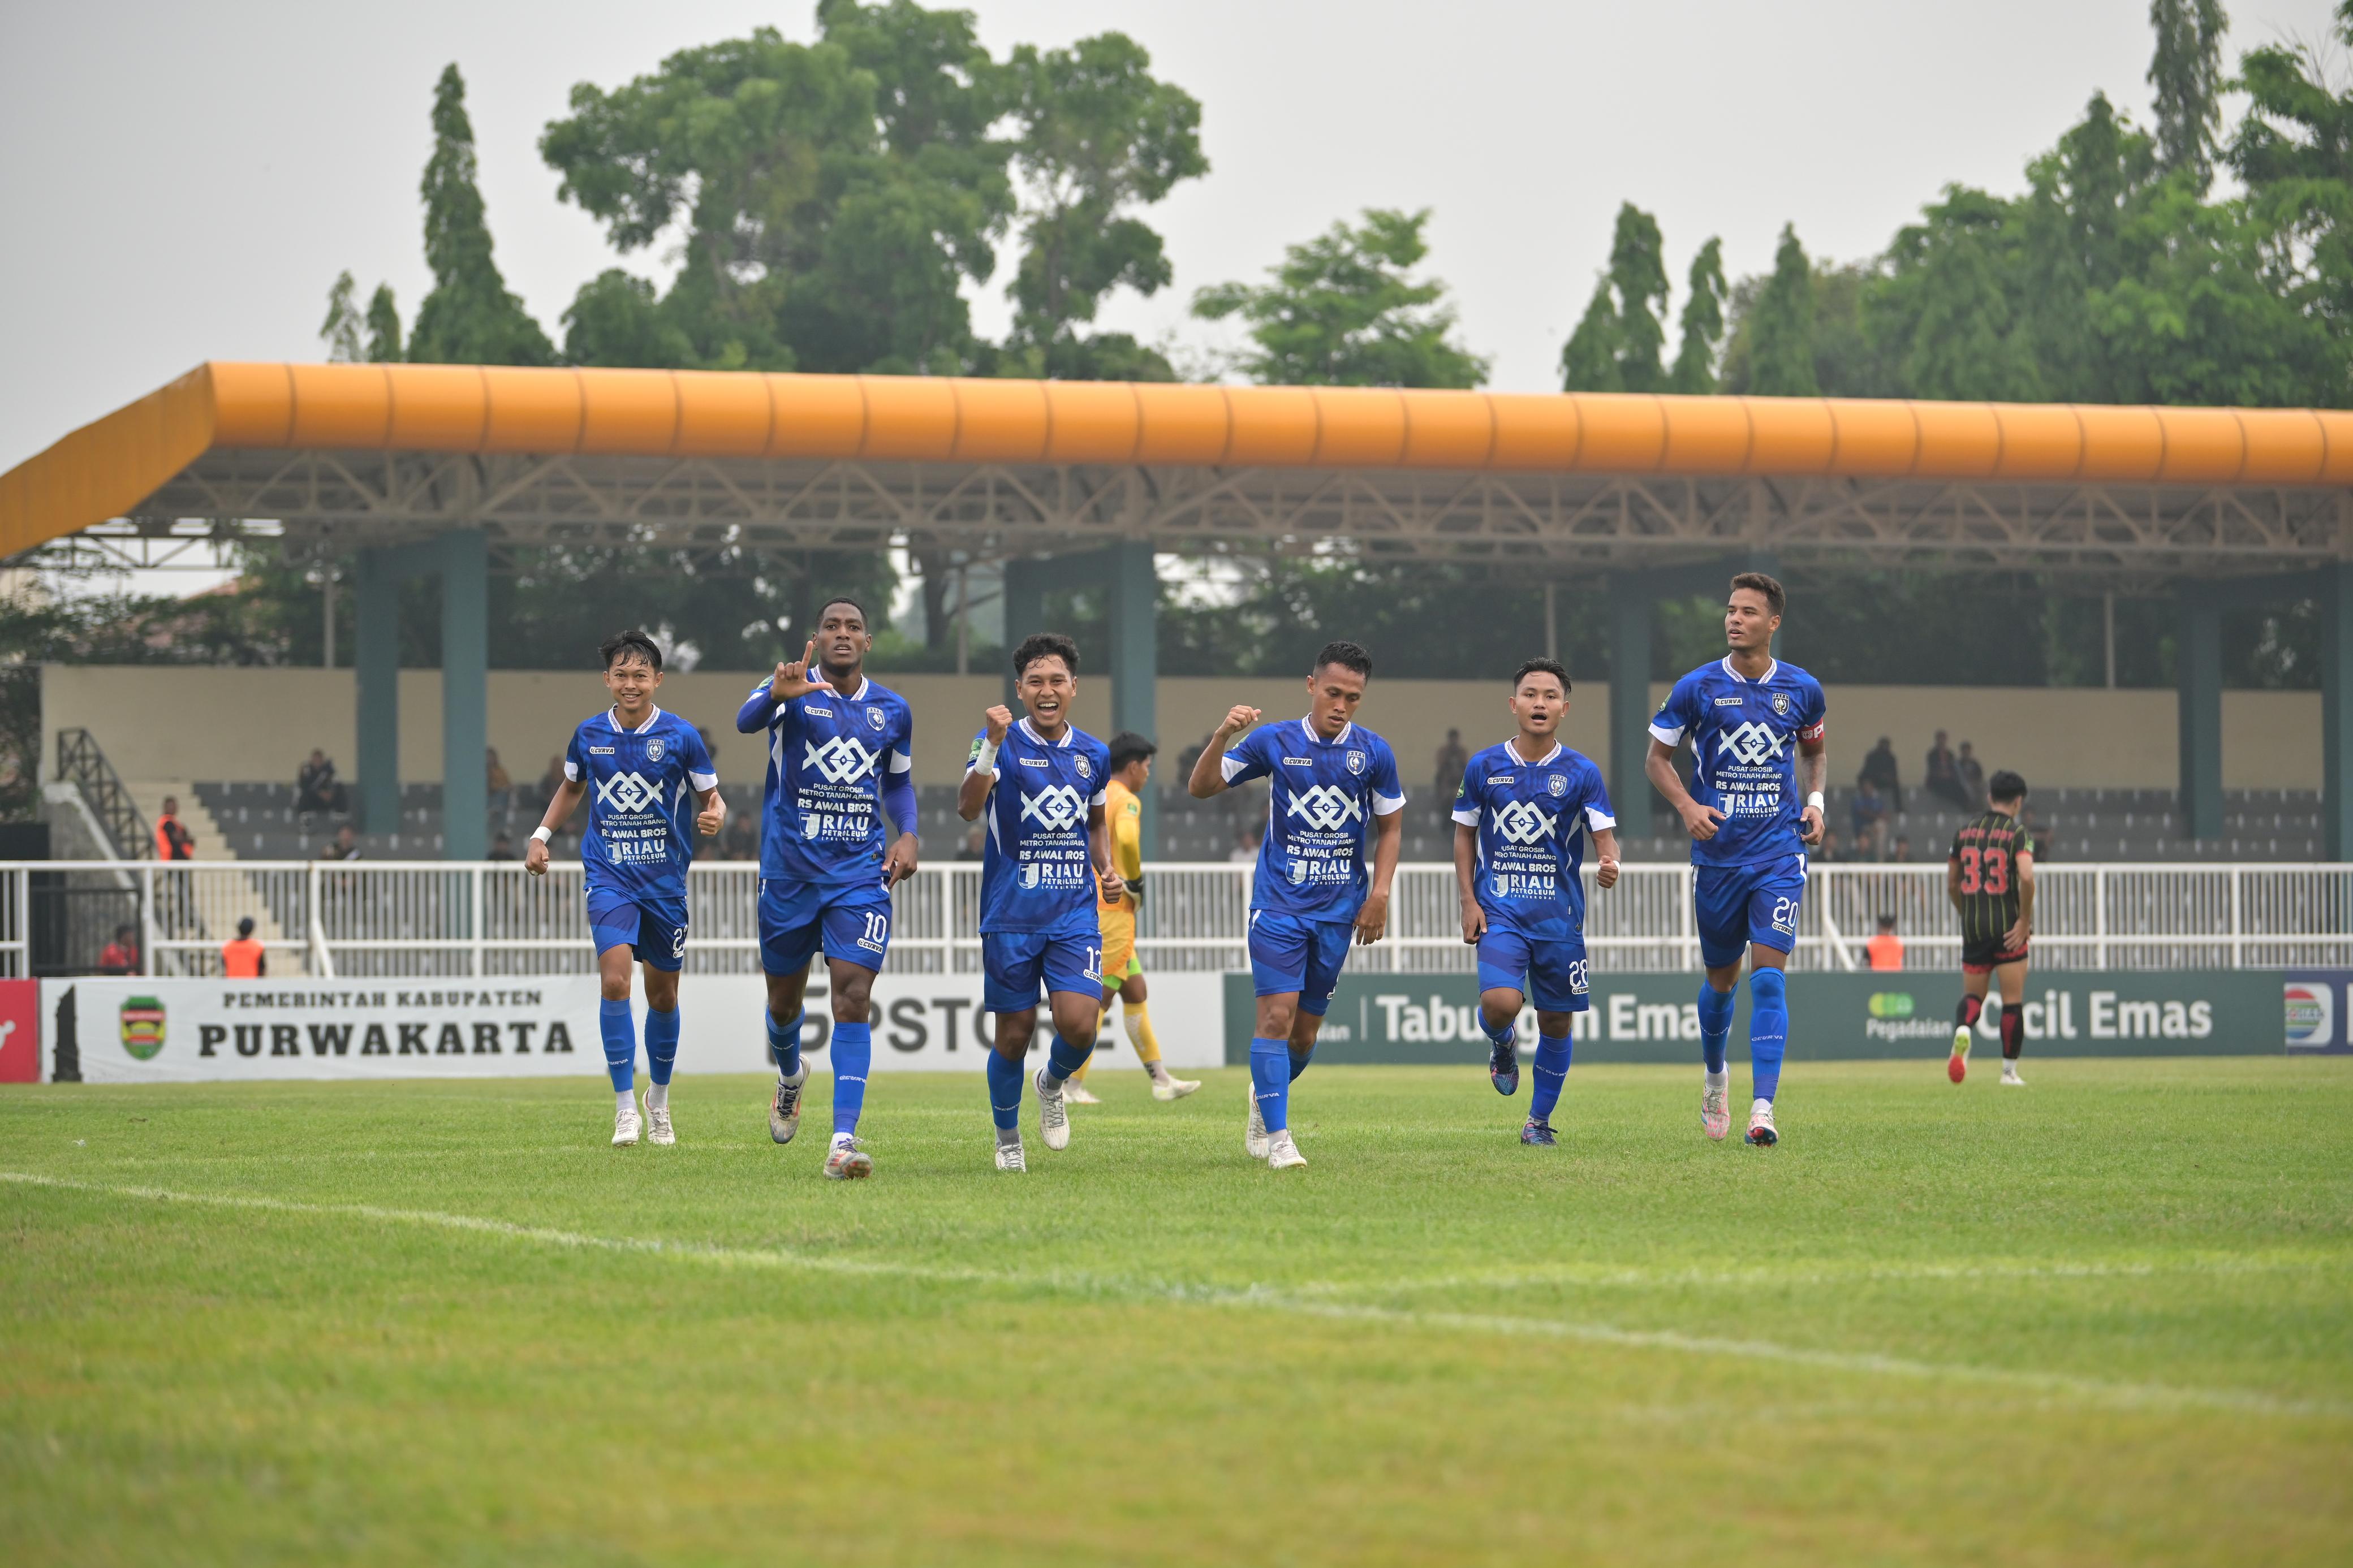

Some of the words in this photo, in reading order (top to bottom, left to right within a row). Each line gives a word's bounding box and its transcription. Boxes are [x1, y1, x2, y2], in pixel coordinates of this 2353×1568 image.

[799, 788, 824, 797] METRO
[1716, 780, 1727, 789] RS
[1730, 782, 1755, 791] AWAL
[1756, 783, 1781, 791] BROS
[798, 798, 812, 809] RS
[815, 801, 845, 812] AWAL
[1736, 794, 1779, 807] RIAU
[822, 815, 869, 831] RIAU
[612, 830, 639, 839] AWAL
[640, 828, 666, 837] BROS
[1287, 835, 1311, 844] METRO
[622, 839, 665, 854] RIAU
[1286, 845, 1300, 855] RS
[1302, 848, 1331, 858] AWAL
[1019, 850, 1031, 860] RS
[1033, 850, 1063, 860] AWAL
[1042, 863, 1084, 878] RIAU
[1309, 859, 1350, 875] RIAU
[1492, 861, 1501, 870] RS
[1501, 862, 1527, 871] AWAL
[1529, 863, 1556, 873] BROS
[1960, 846, 2007, 895] 33
[1510, 874, 1554, 889] RIAU
[1511, 887, 1555, 896] PETROLEUM
[1773, 897, 1798, 927] 20
[864, 912, 887, 943] 10
[1569, 959, 1588, 987] 28
[223, 991, 387, 1009] PEMERINTAH
[397, 990, 541, 1007] KABUPATEN
[1976, 989, 2078, 1039] Ccil
[2089, 991, 2212, 1039] Emas
[1374, 994, 1601, 1055] Tabugn
[1609, 994, 1731, 1040] Ema
[1866, 1017, 1952, 1043] Pegadaian
[199, 1022, 574, 1057] PURWAKARTA
